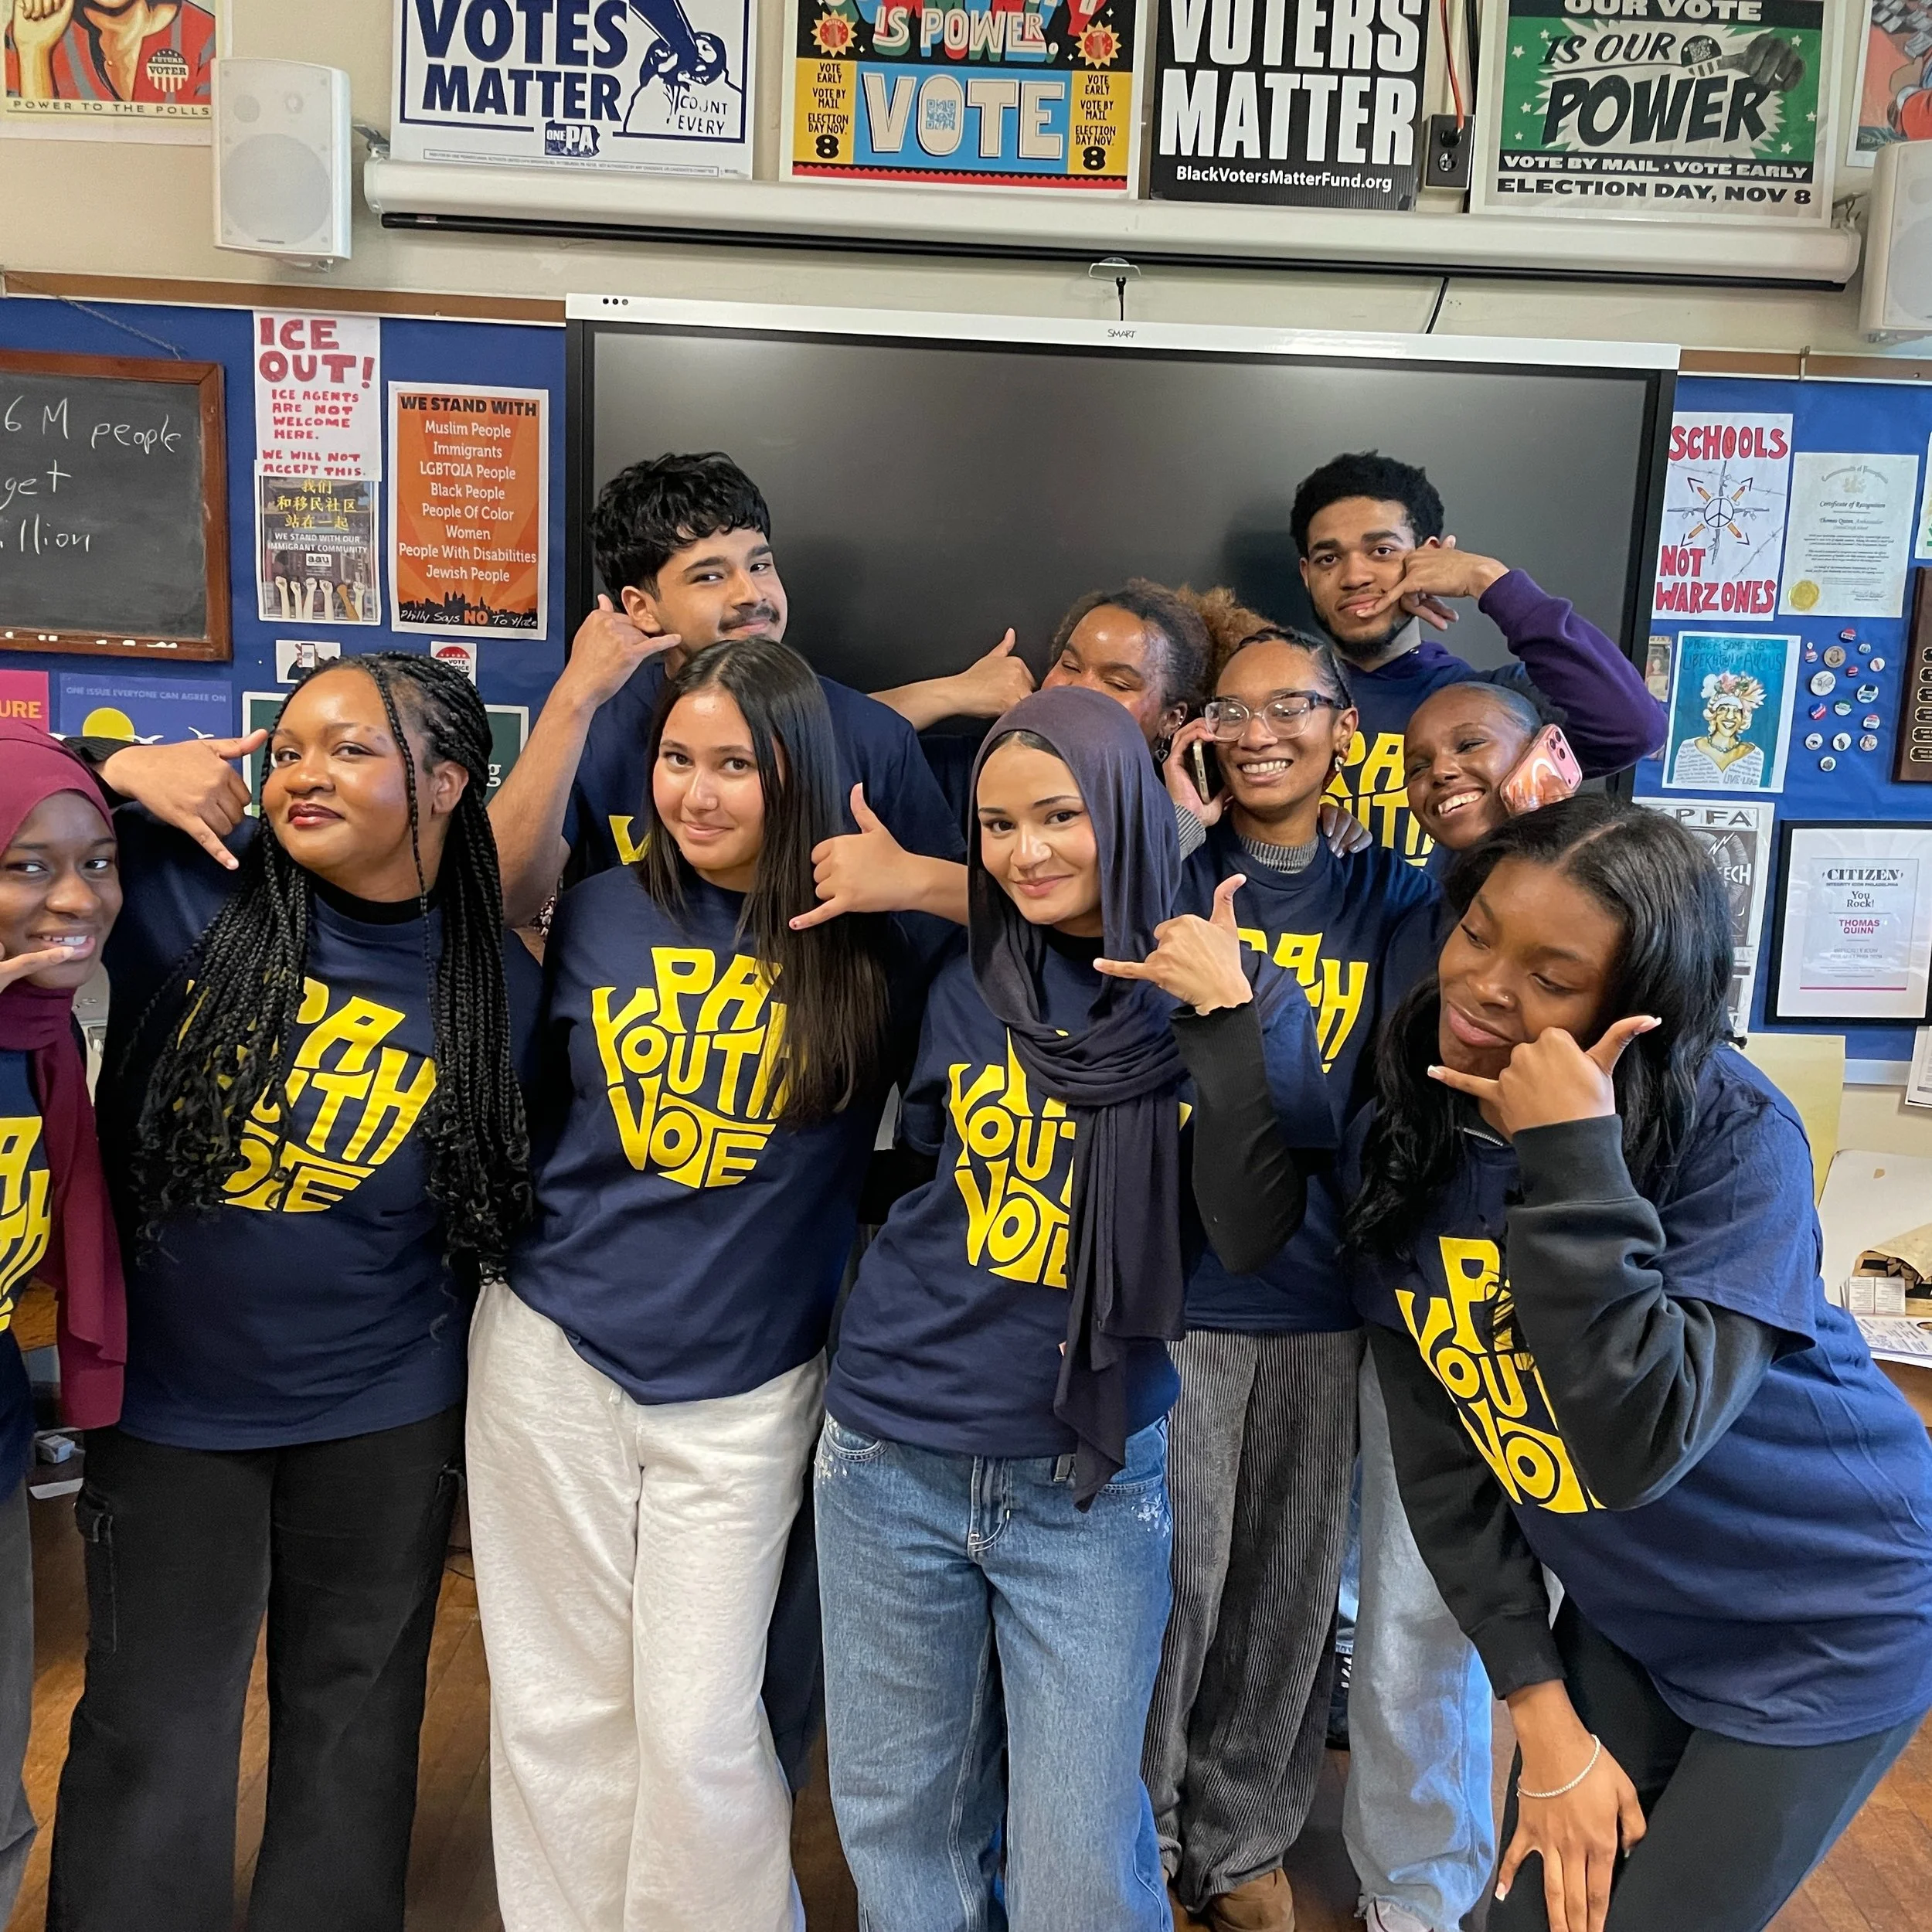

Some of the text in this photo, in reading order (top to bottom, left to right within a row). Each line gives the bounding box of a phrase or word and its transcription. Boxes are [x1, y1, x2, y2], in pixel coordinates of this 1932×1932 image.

[1565, 0, 1762, 21] OUR VOTE
[417, 0, 628, 69] VOTES
[873, 7, 909, 54] IS
[1169, 0, 1421, 72] VOTERS
[1538, 32, 1676, 66] IS OUR
[149, 66, 187, 76] VOTER
[819, 63, 841, 73] VOTE
[817, 73, 842, 84] EARLY
[1087, 75, 1109, 86] VOTE
[422, 64, 621, 122] MATTER
[812, 87, 846, 100] VOTE BY
[1085, 85, 1110, 95] EARLY
[13, 100, 209, 115] POWER TO THE POLLS
[818, 97, 839, 109] MAIL
[1080, 100, 1114, 112] VOTE BY
[1541, 74, 1772, 147] POWER
[808, 113, 849, 125] ELECTION
[863, 72, 1065, 159] VOTE
[1085, 110, 1107, 121] MAIL
[1159, 68, 1417, 165] MATTER
[678, 116, 724, 135] EVERY
[808, 123, 826, 133] DAY
[1075, 125, 1116, 137] ELECTION
[546, 125, 595, 152] ONE PA
[815, 134, 838, 158] 8
[1076, 135, 1092, 146] DAY
[1083, 146, 1106, 171] 8
[1503, 155, 1808, 179] VOTE BY MAIL VOTE EARLY
[1176, 165, 1393, 192] BlackVotersMatterFund.org
[1497, 178, 1811, 205] ELECTION DAY, NOV 8
[260, 317, 339, 350] ICE
[1107, 328, 1137, 338] SMART
[259, 351, 375, 388] OUT!
[271, 389, 359, 403] ICE AGENTS
[272, 403, 353, 415] ARE NOT
[400, 396, 536, 417] WE STAND WITH
[43, 398, 68, 439] M
[90, 415, 182, 454] people
[274, 416, 350, 428] WELCOME
[425, 420, 512, 440] Muslim People
[274, 430, 319, 440] HERE.
[1668, 425, 1788, 461] SCHOOLS
[262, 450, 360, 462] WE WILL NOT
[434, 441, 502, 459] Immigrants
[263, 464, 366, 476] ACCEPT THIS.
[420, 461, 516, 481] LGBTQIA People
[0, 459, 73, 510] get
[301, 478, 332, 495] 我们
[430, 482, 505, 502] Black People
[277, 495, 357, 513] 和移民社区
[422, 503, 514, 522] People Of Color
[285, 514, 349, 532] 站在一起
[446, 525, 491, 540] Women
[0, 513, 90, 555] llion
[274, 532, 360, 543] WE STAND WITH OUR
[267, 542, 367, 553] IMMIGRANT COMMUNITY
[399, 543, 537, 564] People With Disabilities
[308, 556, 330, 564] aau
[1659, 546, 1706, 577] NOT
[426, 564, 510, 583] Jewish People
[1655, 580, 1776, 614] WARZONES
[400, 610, 538, 628] Philly Says NO To Hate
[66, 686, 226, 702] ONE ISSUE EVERYONE CAN AGREE ON
[0, 699, 43, 718] URE
[1662, 808, 1752, 827] PFA
[1847, 899, 1874, 907] Rock!
[651, 947, 783, 1034] PA
[607, 1073, 776, 1189] VOTE
[1457, 1397, 1607, 1513] VOT
